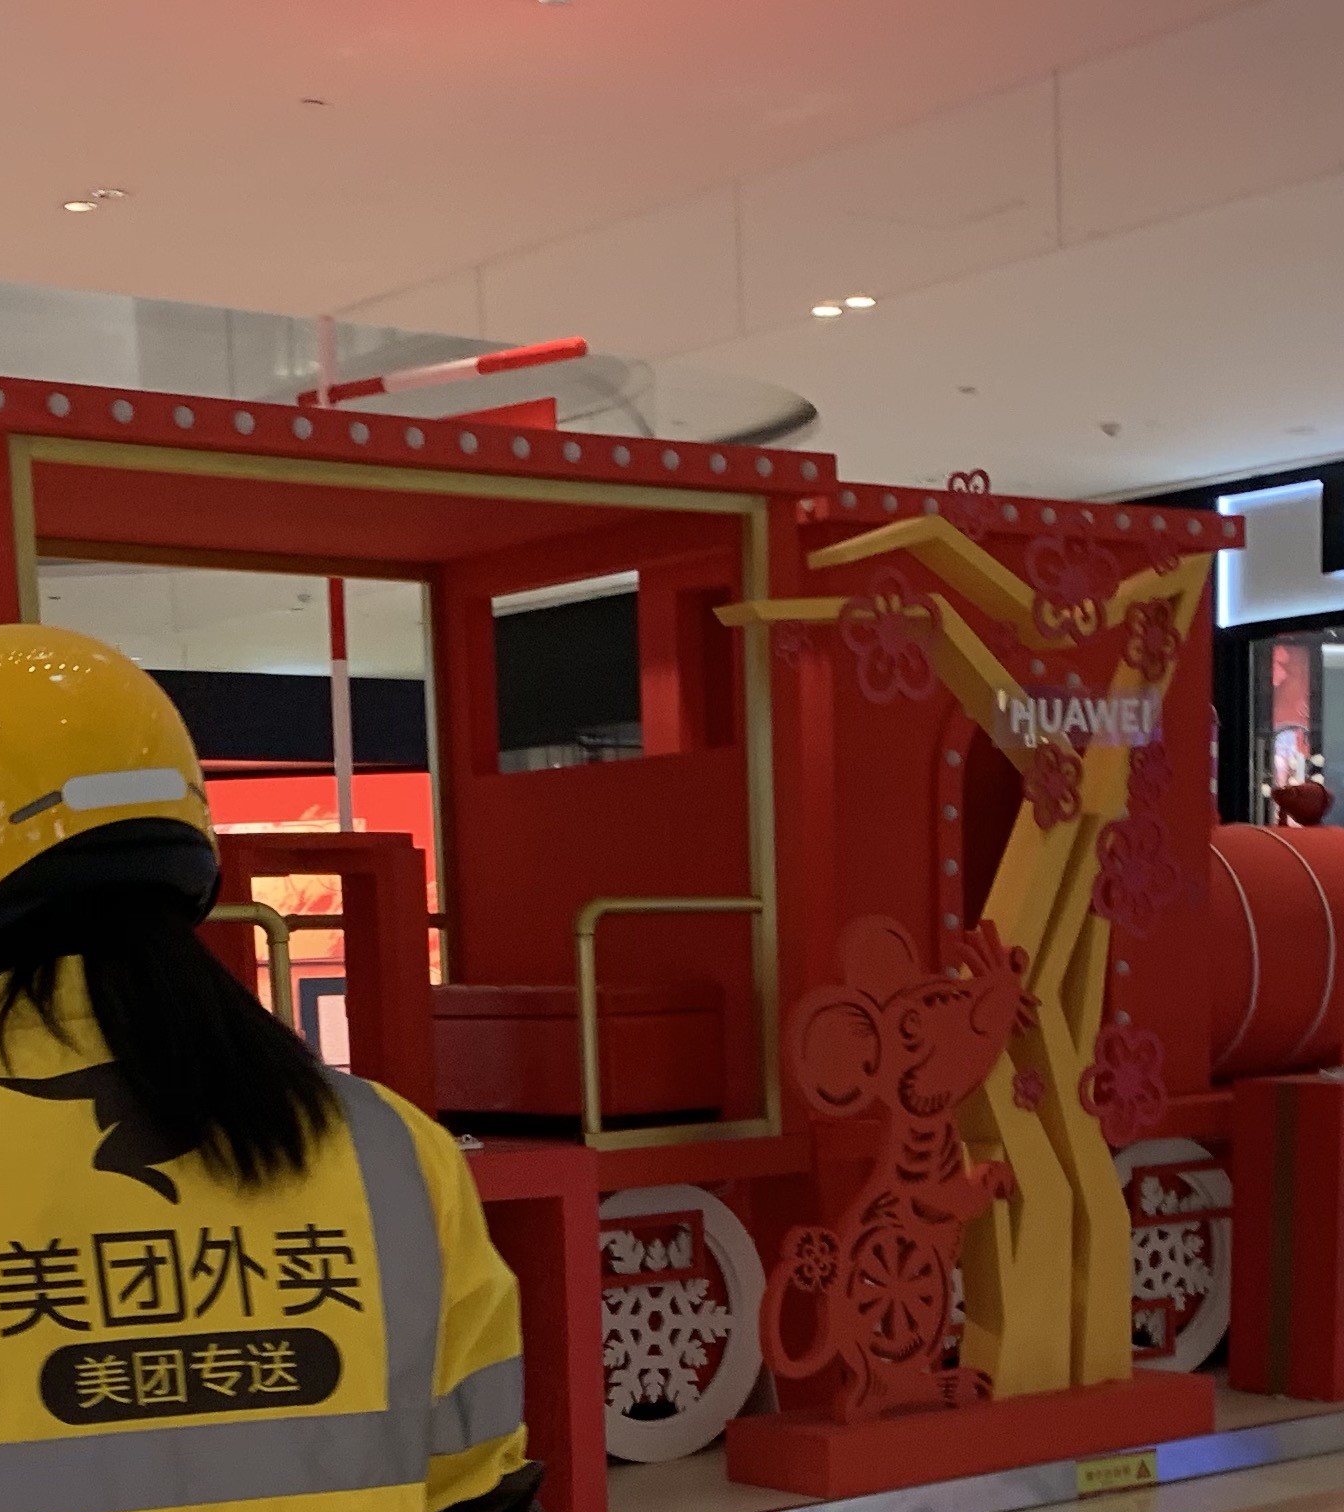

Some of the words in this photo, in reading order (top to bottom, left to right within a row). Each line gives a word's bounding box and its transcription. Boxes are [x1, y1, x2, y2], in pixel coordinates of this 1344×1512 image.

[1009, 696, 1152, 736] HUAWEI
[73, 1340, 302, 1410] 美团专送
